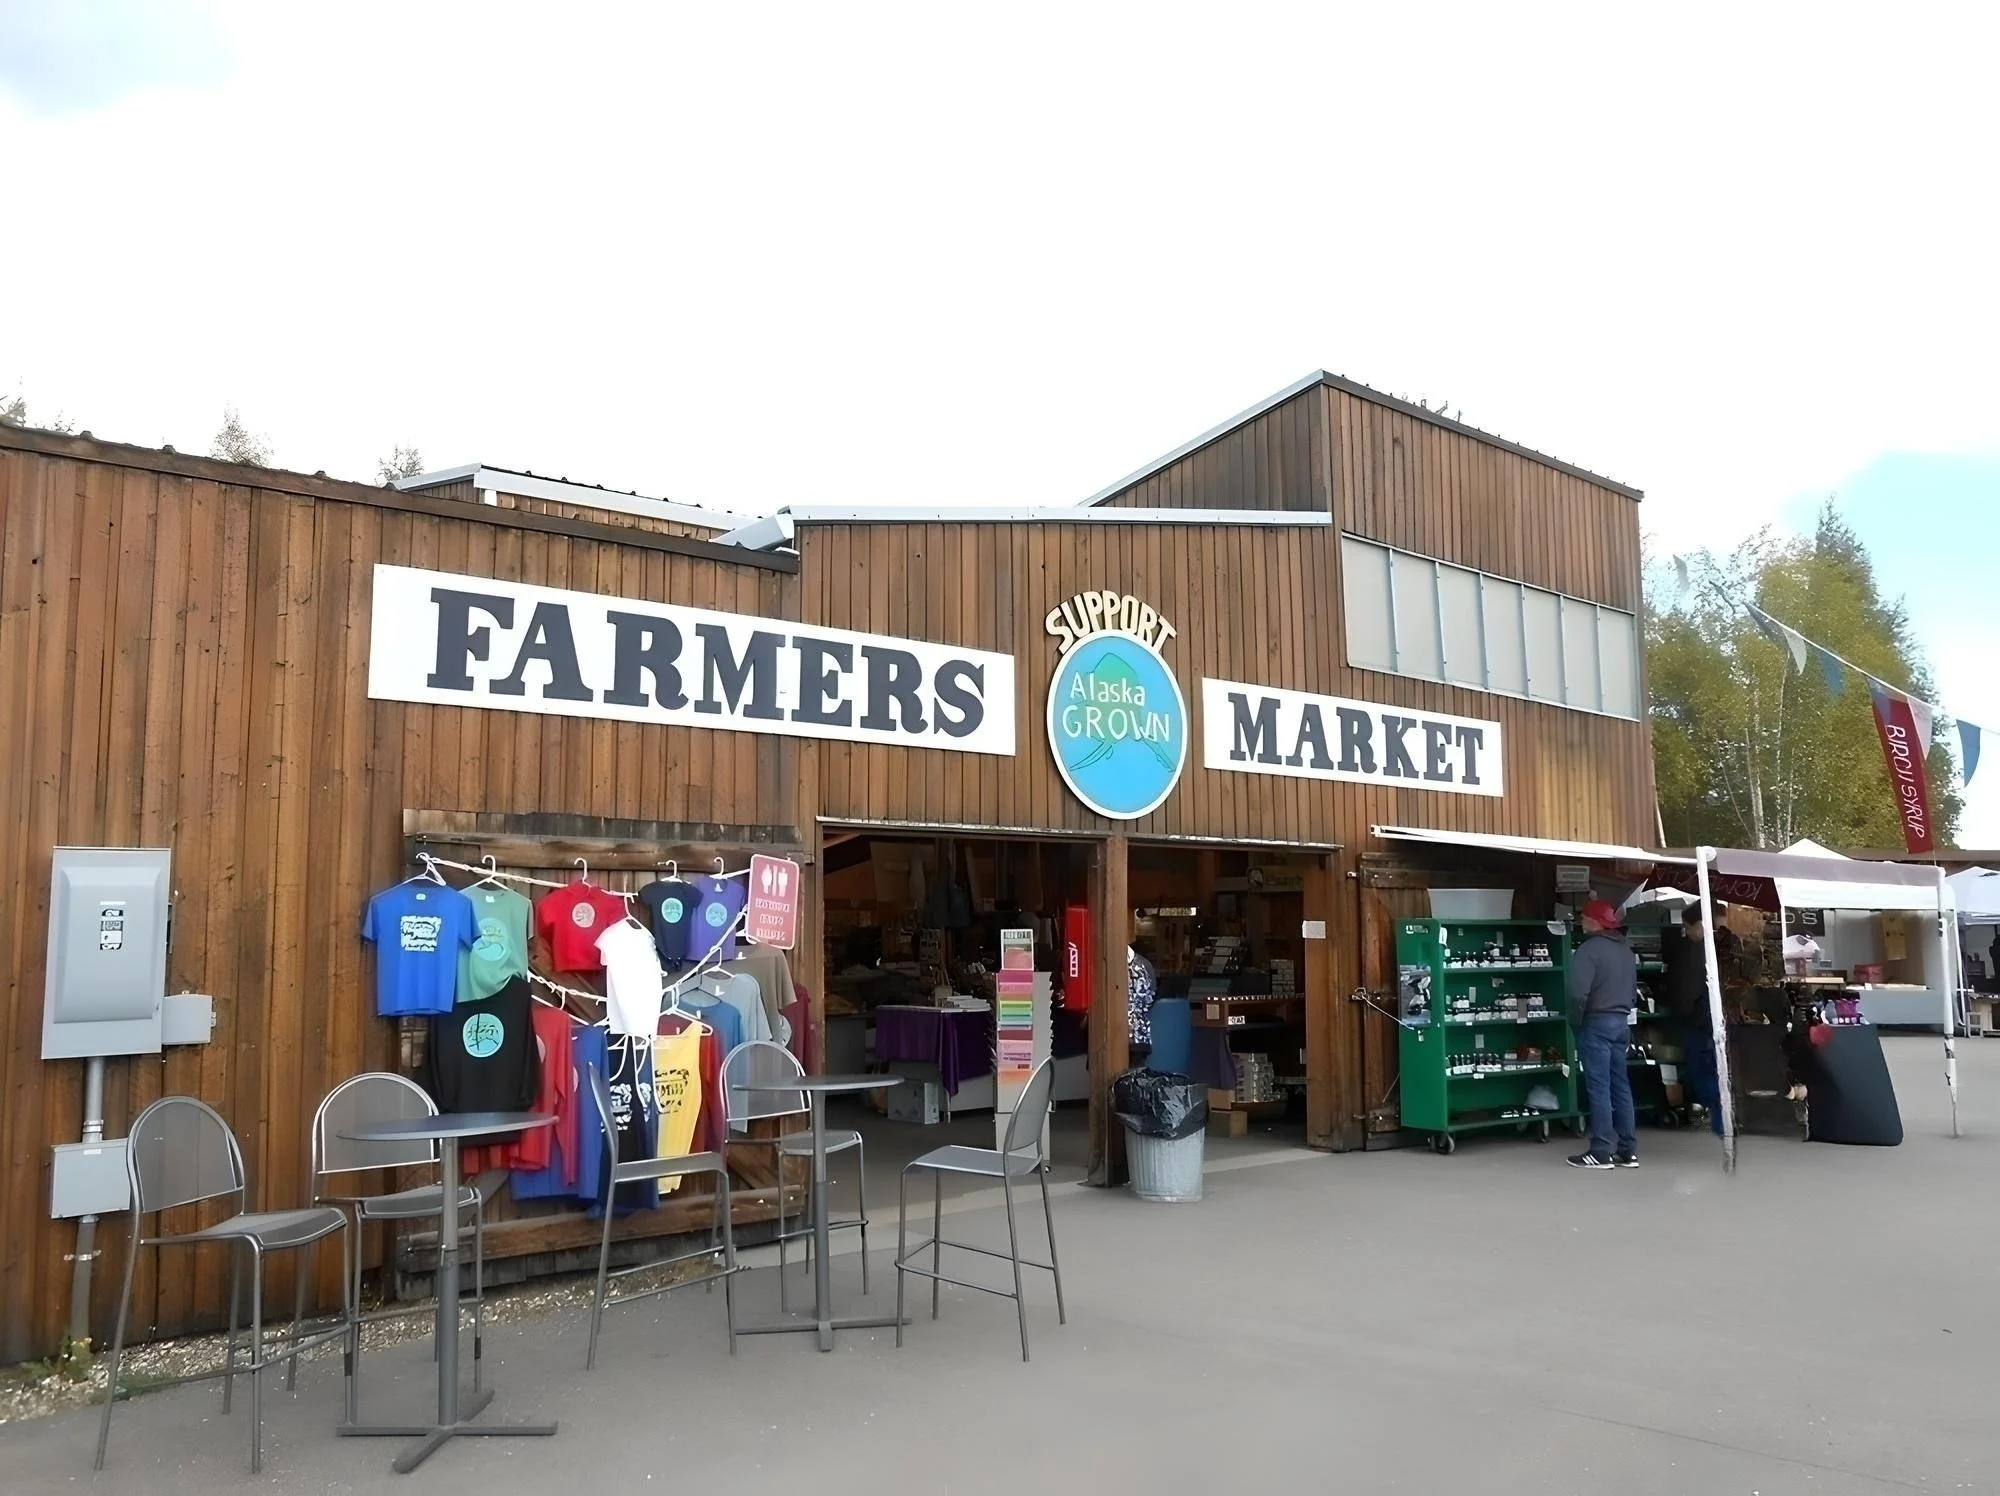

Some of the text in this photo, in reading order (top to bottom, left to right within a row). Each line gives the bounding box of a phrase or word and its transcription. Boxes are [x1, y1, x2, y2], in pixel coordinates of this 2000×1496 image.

[1045, 590, 1177, 655] SUPPORT
[427, 587, 985, 738] FARMERS
[1070, 671, 1147, 707] Alaska
[1062, 704, 1170, 743] GROWN
[1228, 692, 1484, 785] MARKET
[1901, 784, 1925, 838] SYRUP
